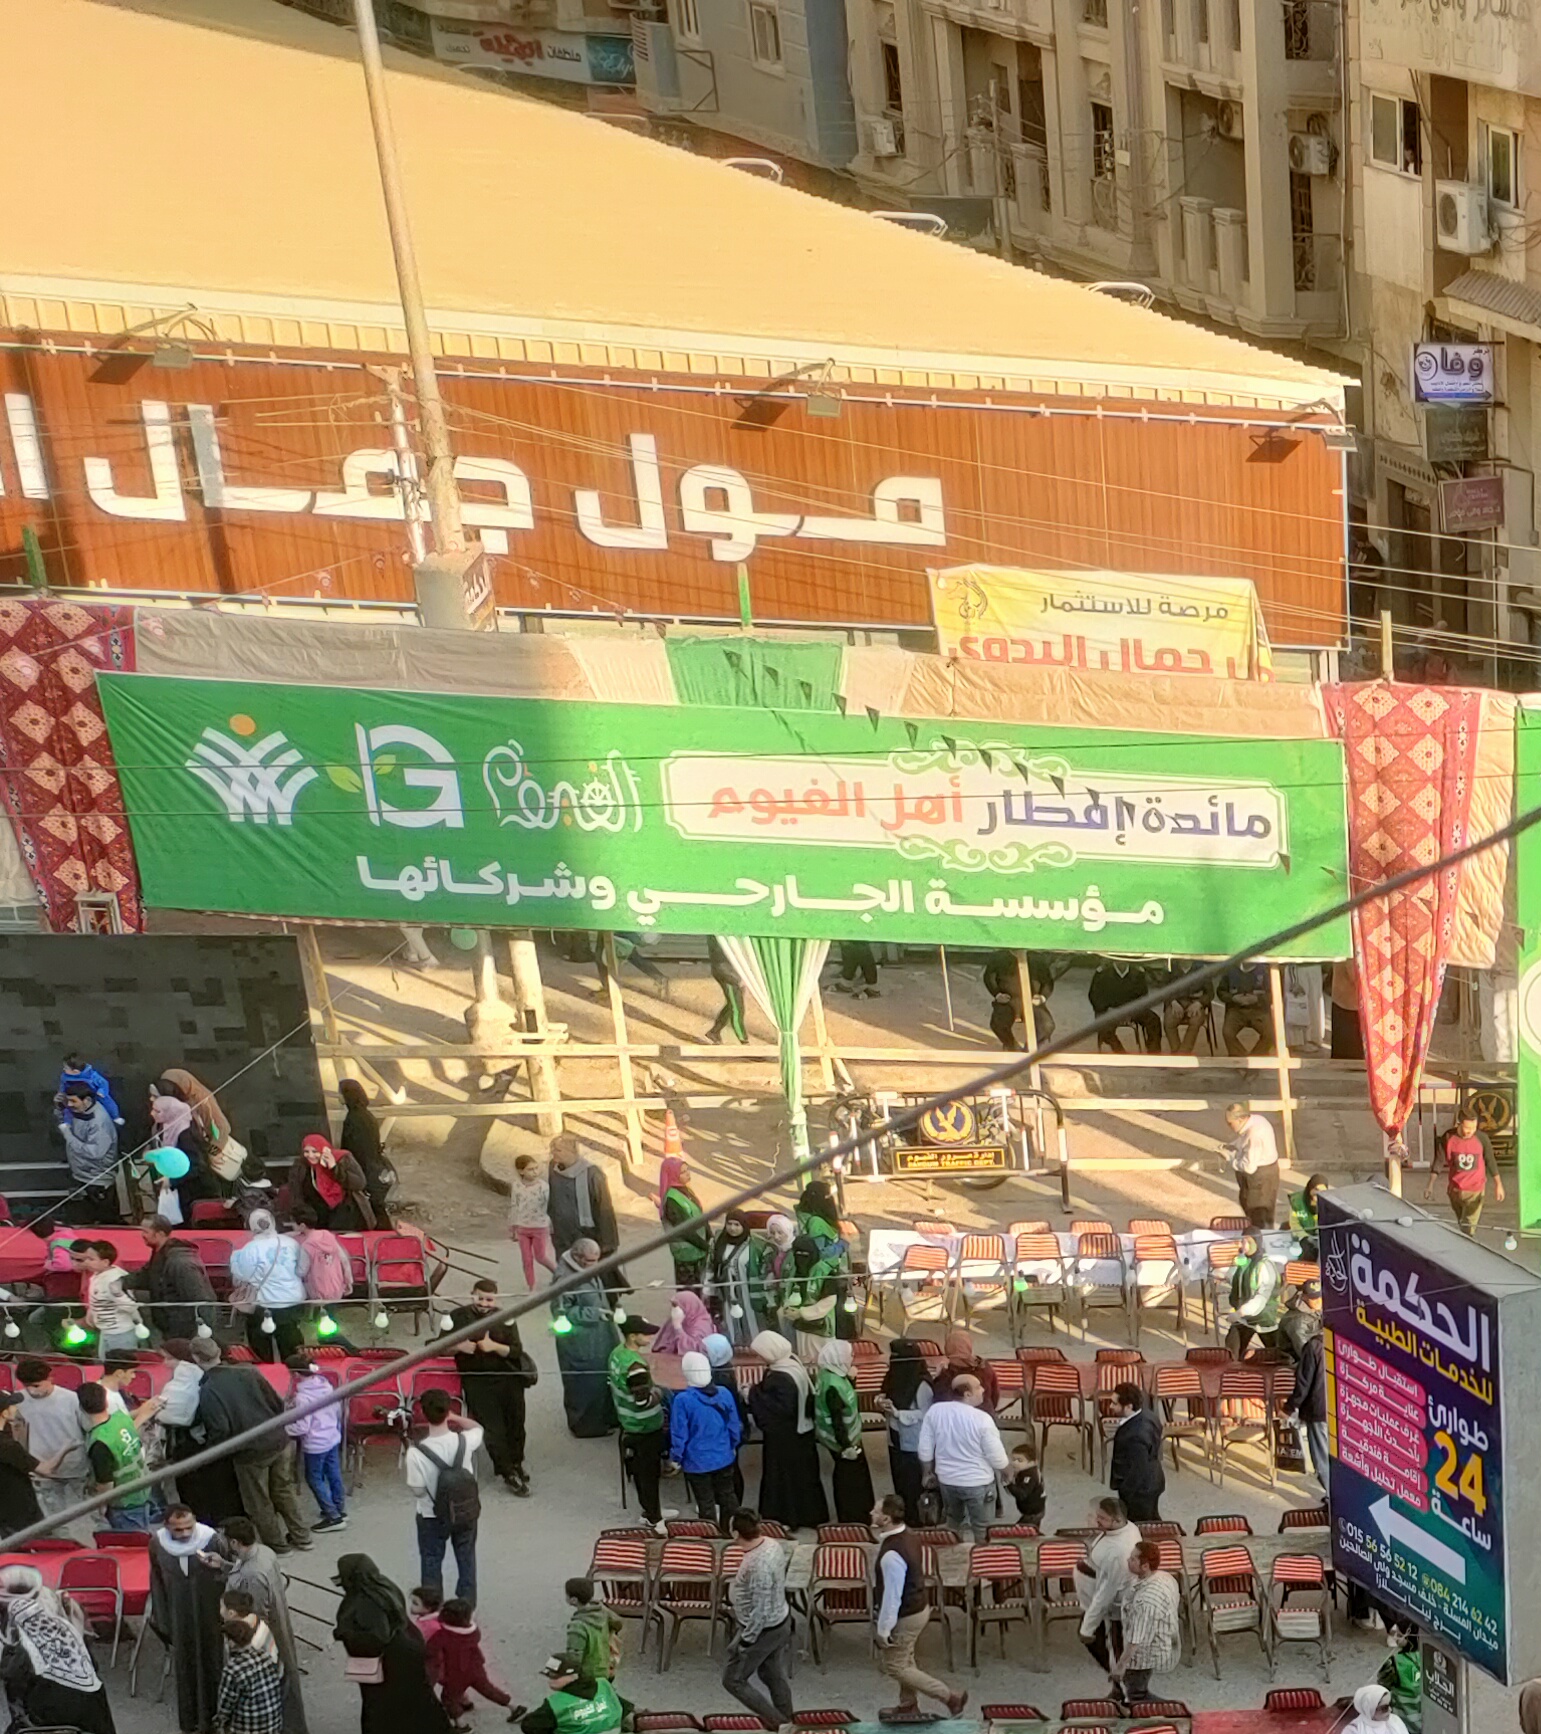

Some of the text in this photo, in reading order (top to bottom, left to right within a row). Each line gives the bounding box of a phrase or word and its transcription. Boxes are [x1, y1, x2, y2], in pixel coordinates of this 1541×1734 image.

[84, 399, 534, 552] جمال
[574, 434, 945, 561] مول
[1040, 591, 1229, 620] فرصة للاستثمار
[707, 776, 1272, 845] مائدة إفطار أهل الفيوم
[357, 854, 1165, 931] مؤسسة الجارحي وشركائها
[1351, 1233, 1490, 1373] الحكمة
[1356, 1299, 1493, 1406] للخدمات الطبية
[1379, 1366, 1418, 1398] استقبال
[1340, 1361, 1419, 1421] عناية مركزة
[1340, 1386, 1420, 1444] غرف عمليات مجهزة
[1342, 1427, 1421, 1491] إقامة فندقية
[1342, 1447, 1421, 1507] معمل وأشعة
[1434, 1430, 1487, 1517] 24
[1347, 1522, 1418, 1579] 015 56 56 52 12
[1431, 1489, 1492, 1551] ساعة
[1339, 1537, 1499, 1650] ميدان خلف مسجد الصالحين
[1429, 1575, 1498, 1636] 084 214 62 42
[1433, 1614, 1462, 1645] برج
